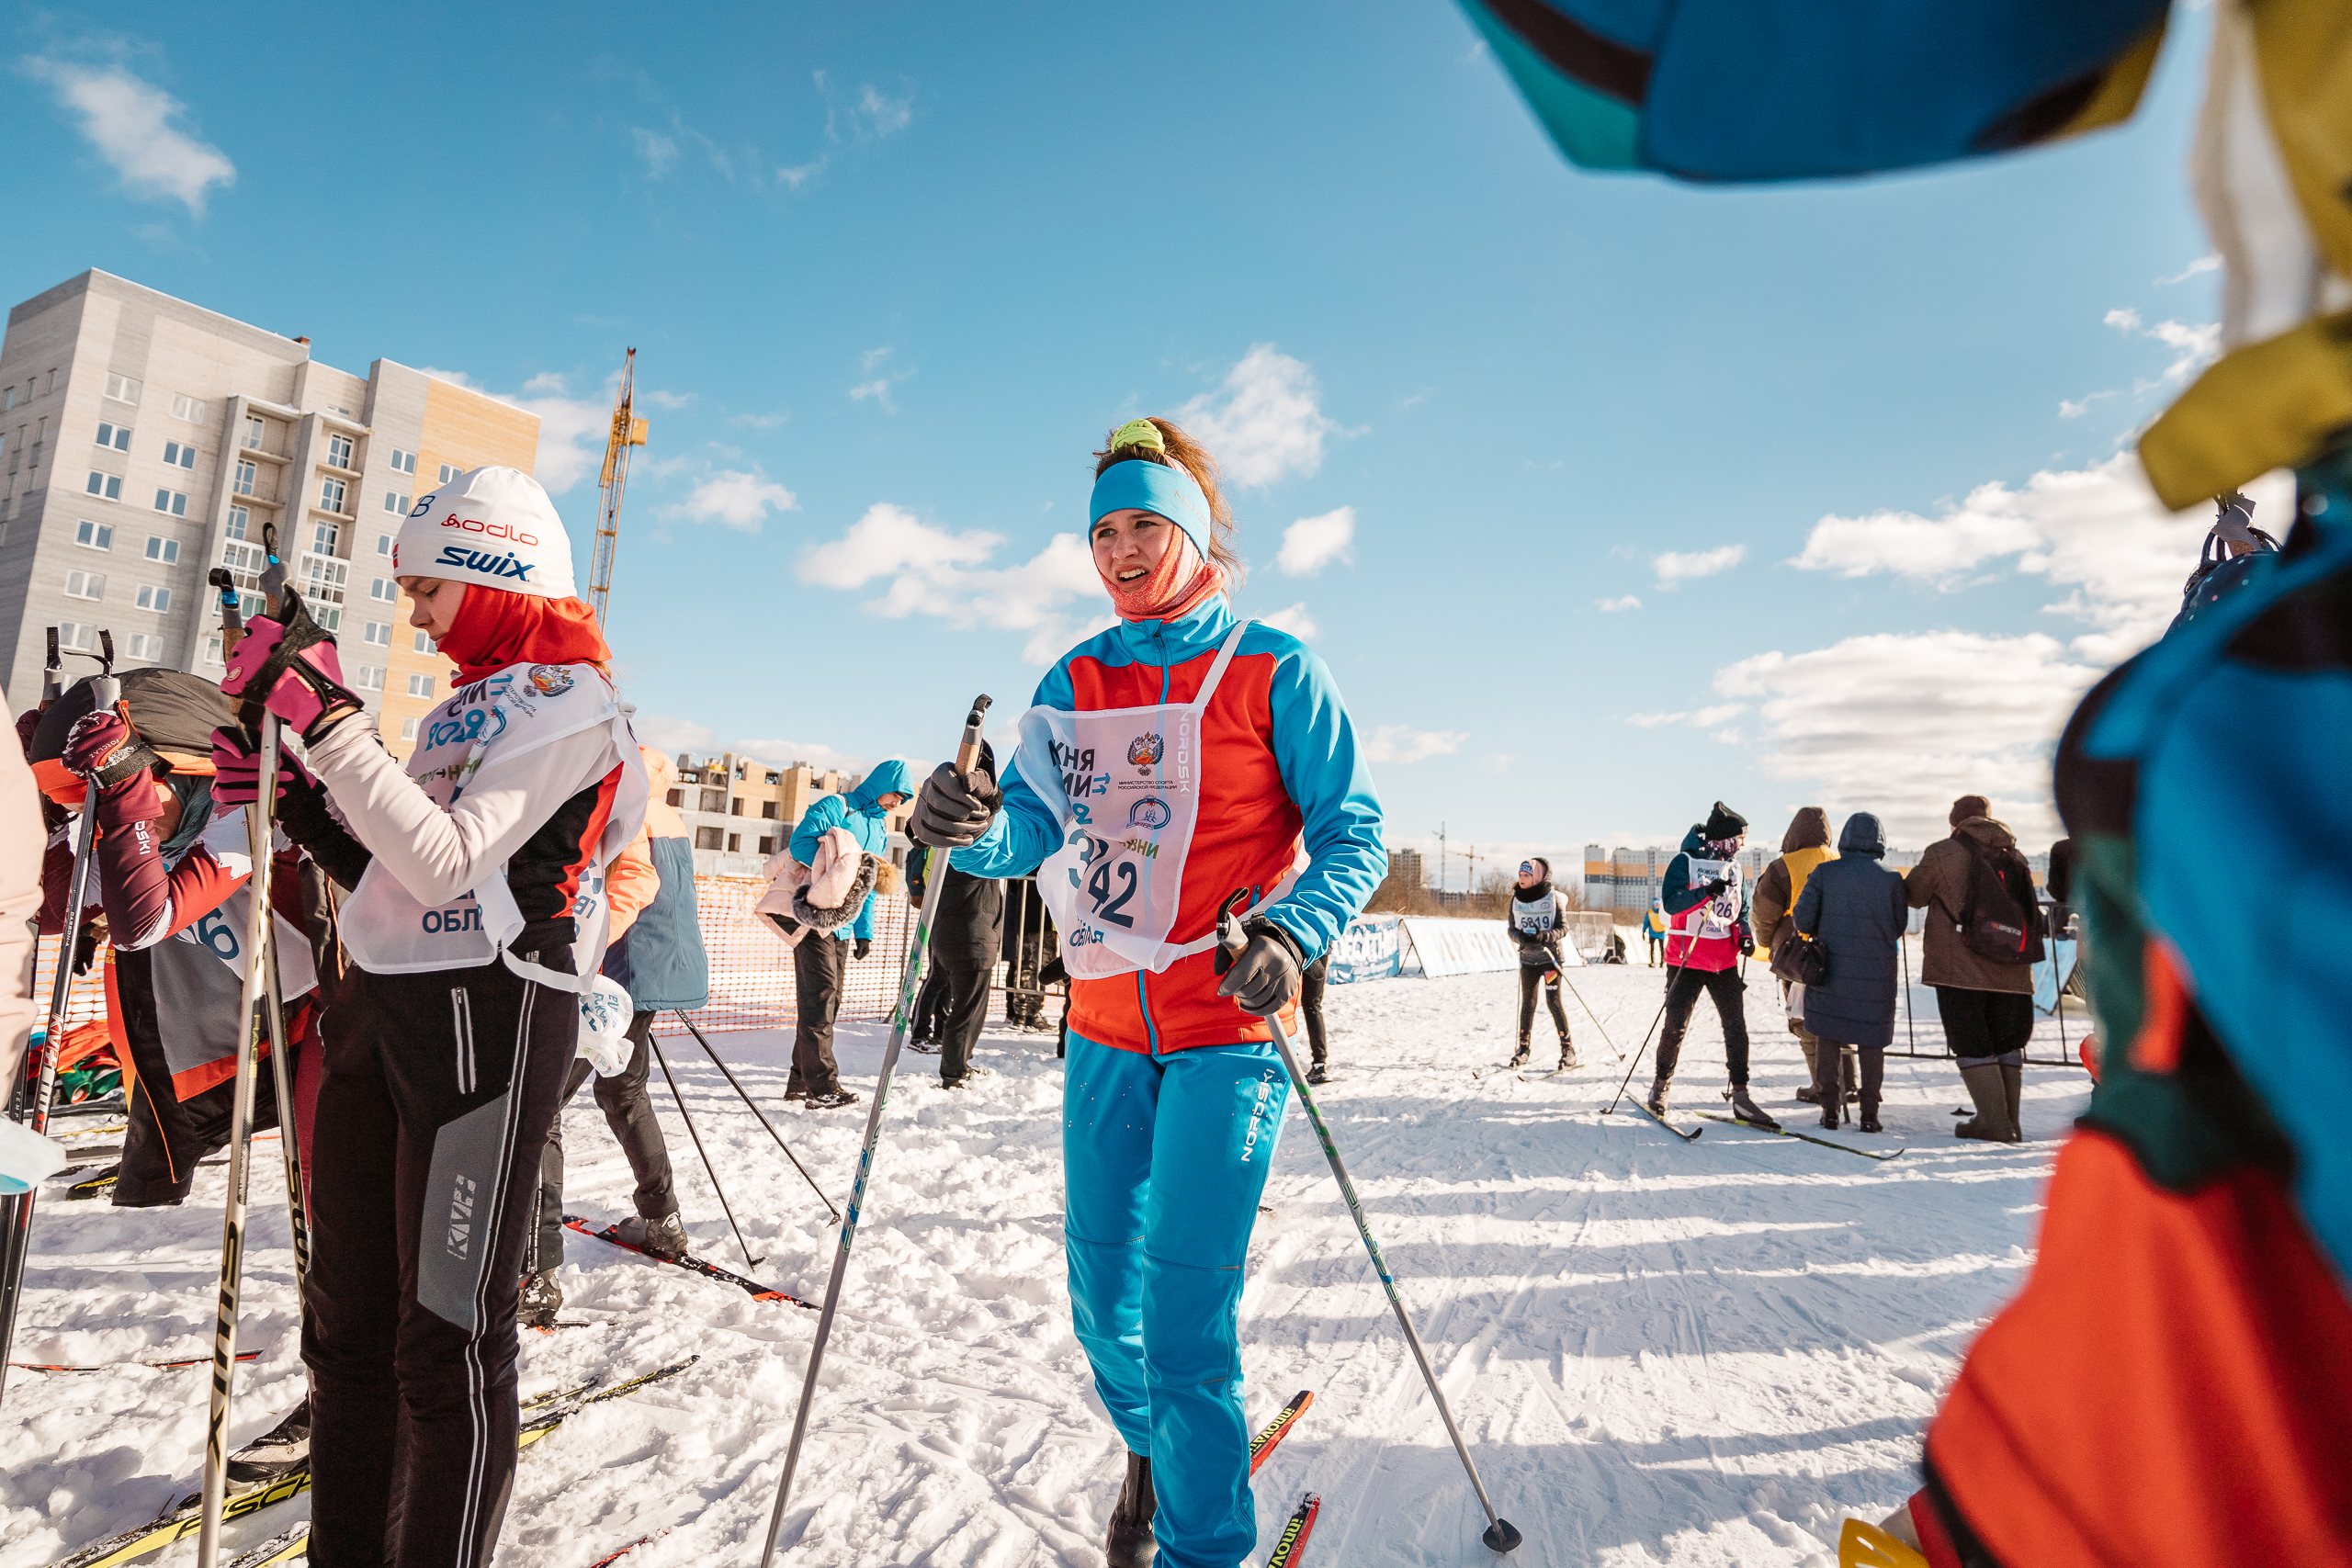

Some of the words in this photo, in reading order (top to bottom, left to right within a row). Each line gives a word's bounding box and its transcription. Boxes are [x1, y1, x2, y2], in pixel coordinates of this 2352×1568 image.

[89, 738, 120, 759] FORCLAZ
[134, 820, 151, 855] DSKI
[422, 907, 484, 934] ОБЛ
[1521, 916, 1550, 929] 5819
[1241, 1067, 1275, 1162] NORDSKI
